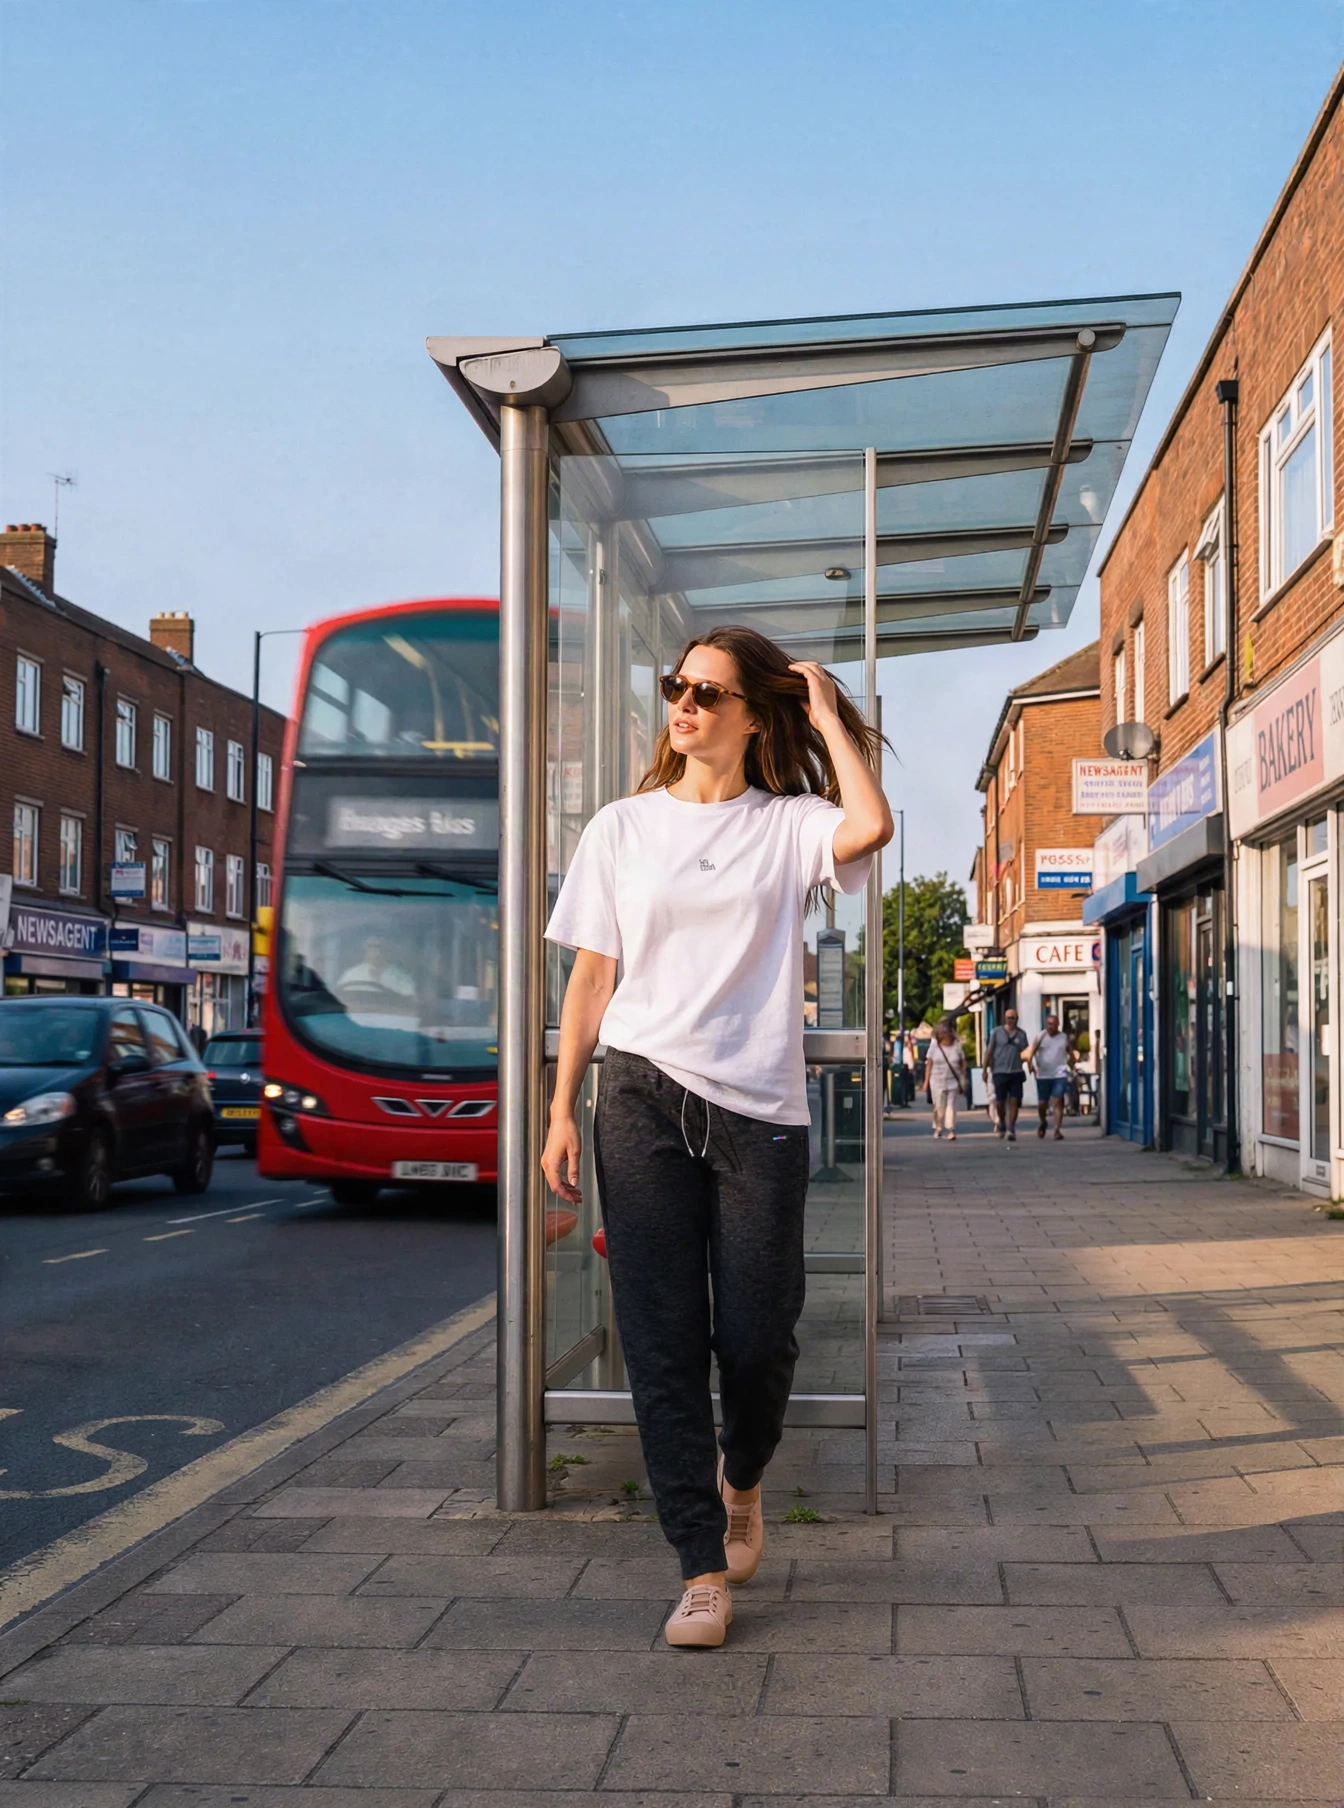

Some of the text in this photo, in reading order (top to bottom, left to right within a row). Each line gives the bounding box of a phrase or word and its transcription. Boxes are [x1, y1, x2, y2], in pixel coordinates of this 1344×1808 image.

[1258, 687, 1316, 793] BAKERY
[17, 915, 97, 951] NEWSAGENT
[1036, 945, 1084, 963] CAFE
